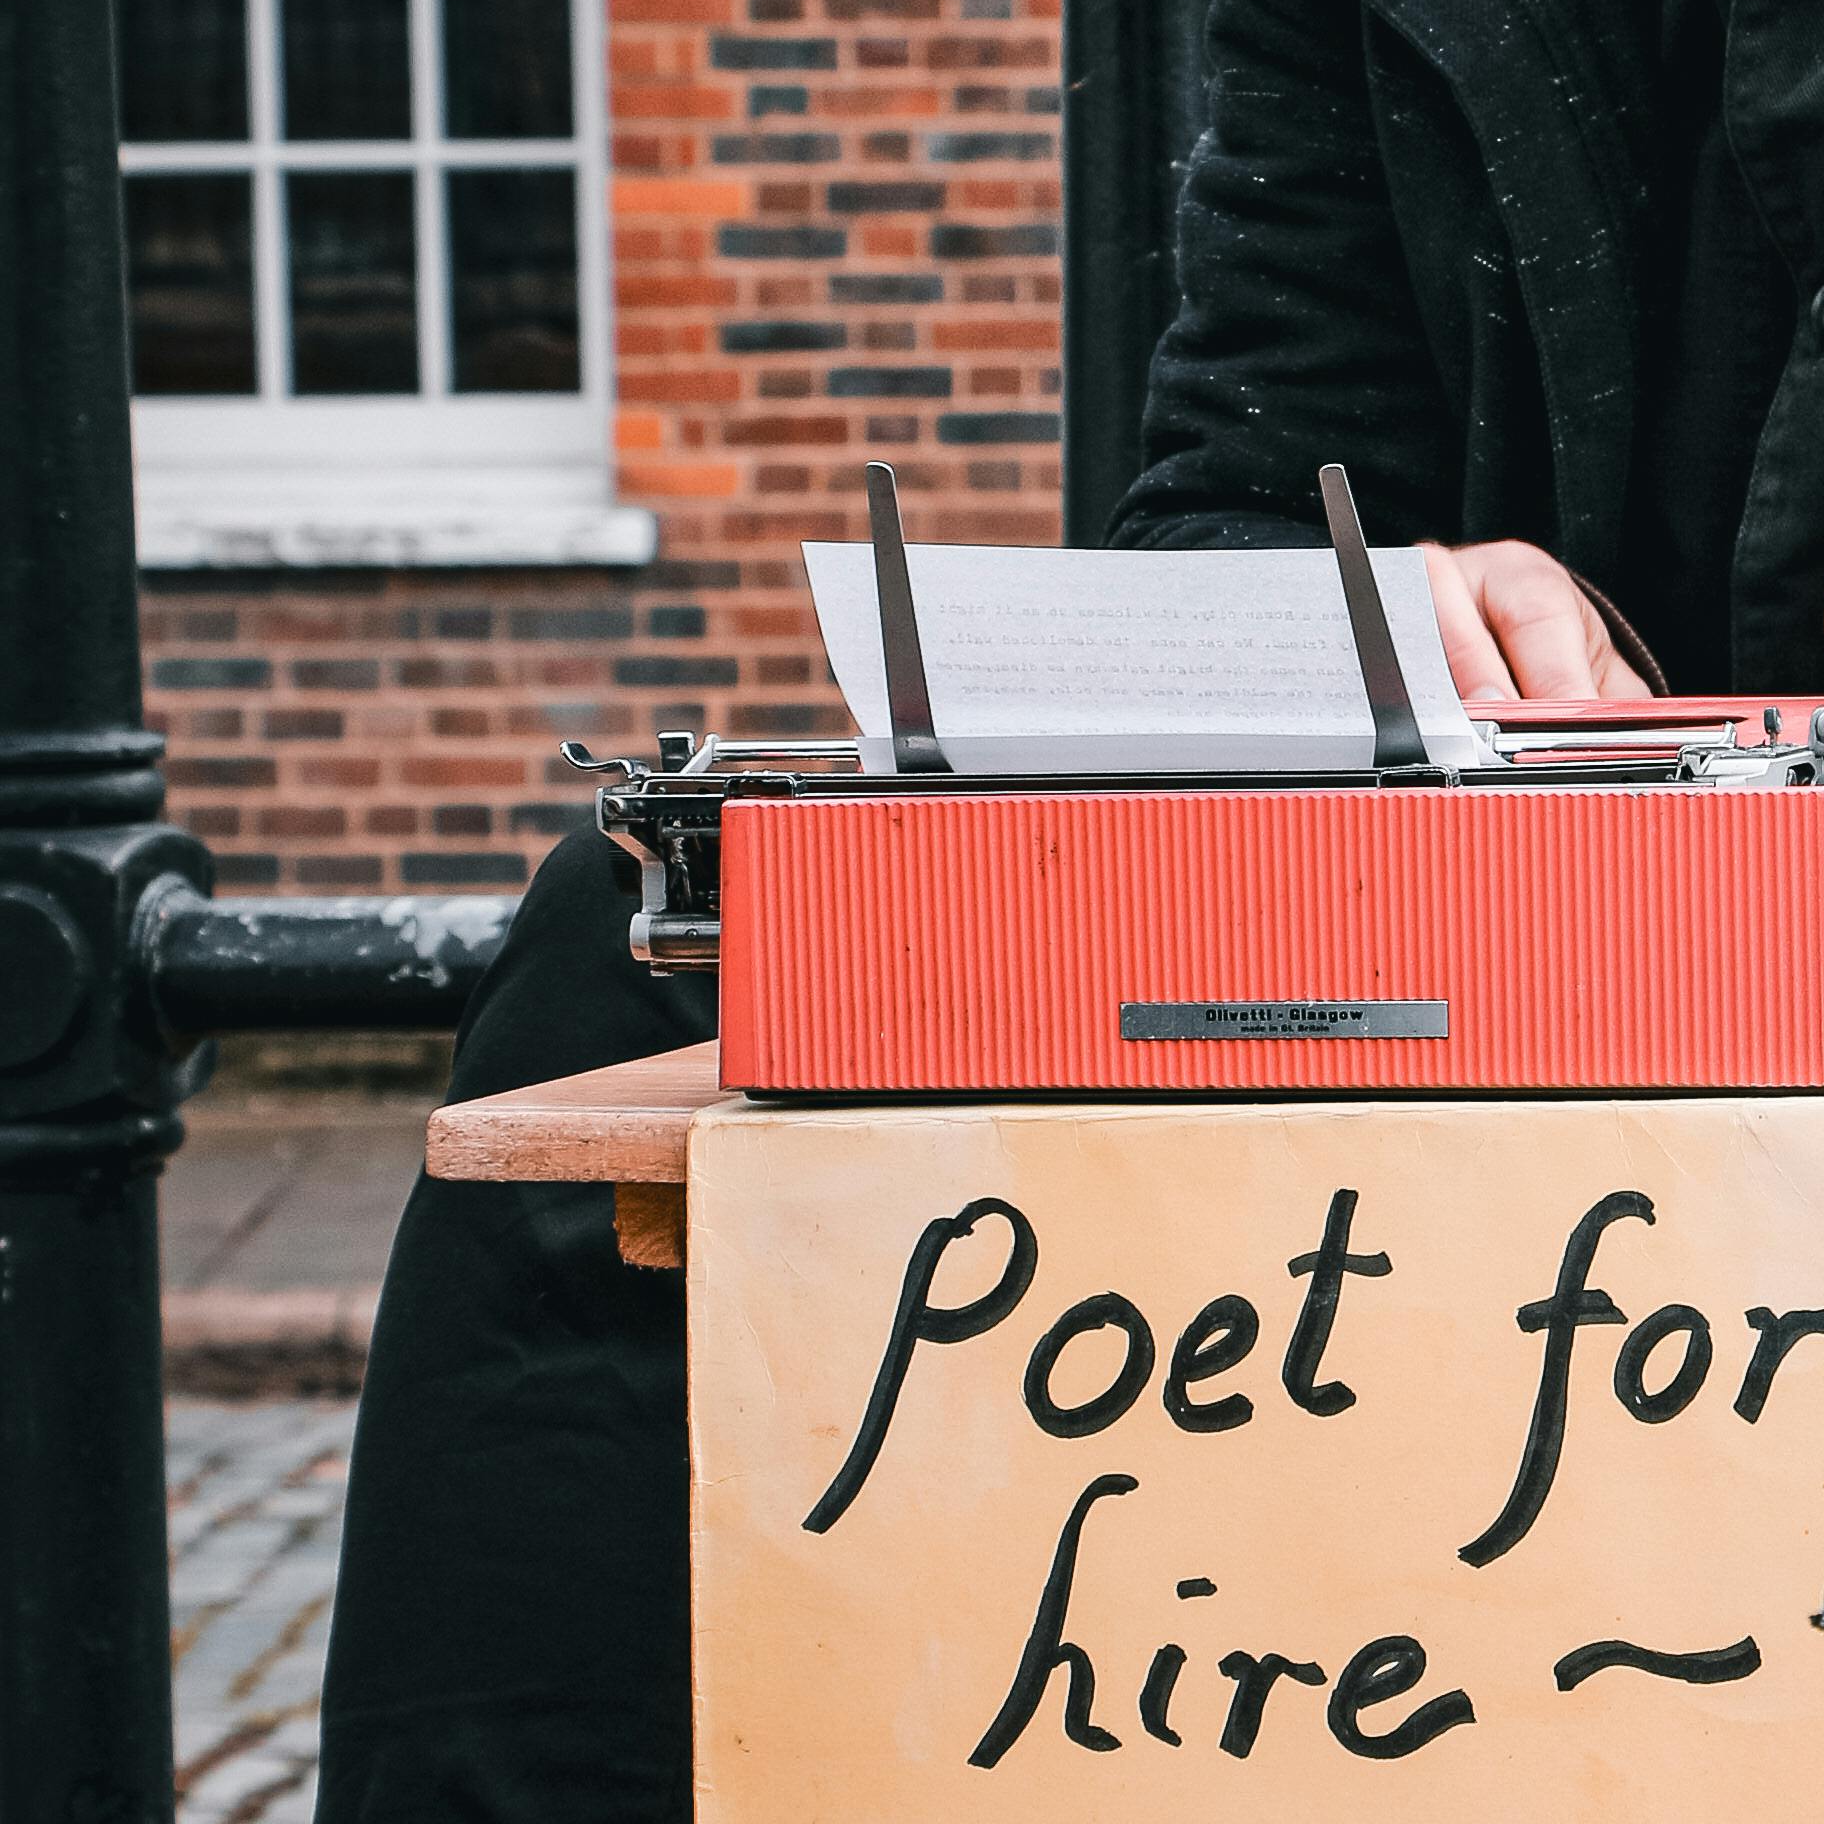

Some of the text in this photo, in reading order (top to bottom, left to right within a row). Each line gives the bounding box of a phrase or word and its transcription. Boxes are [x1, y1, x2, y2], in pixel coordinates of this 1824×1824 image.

[1205, 1009, 1272, 1022] Olivetti
[1289, 1009, 1364, 1024] Glasgow
[801, 1188, 1394, 1537] Poet
[966, 1474, 1477, 1771] hire
